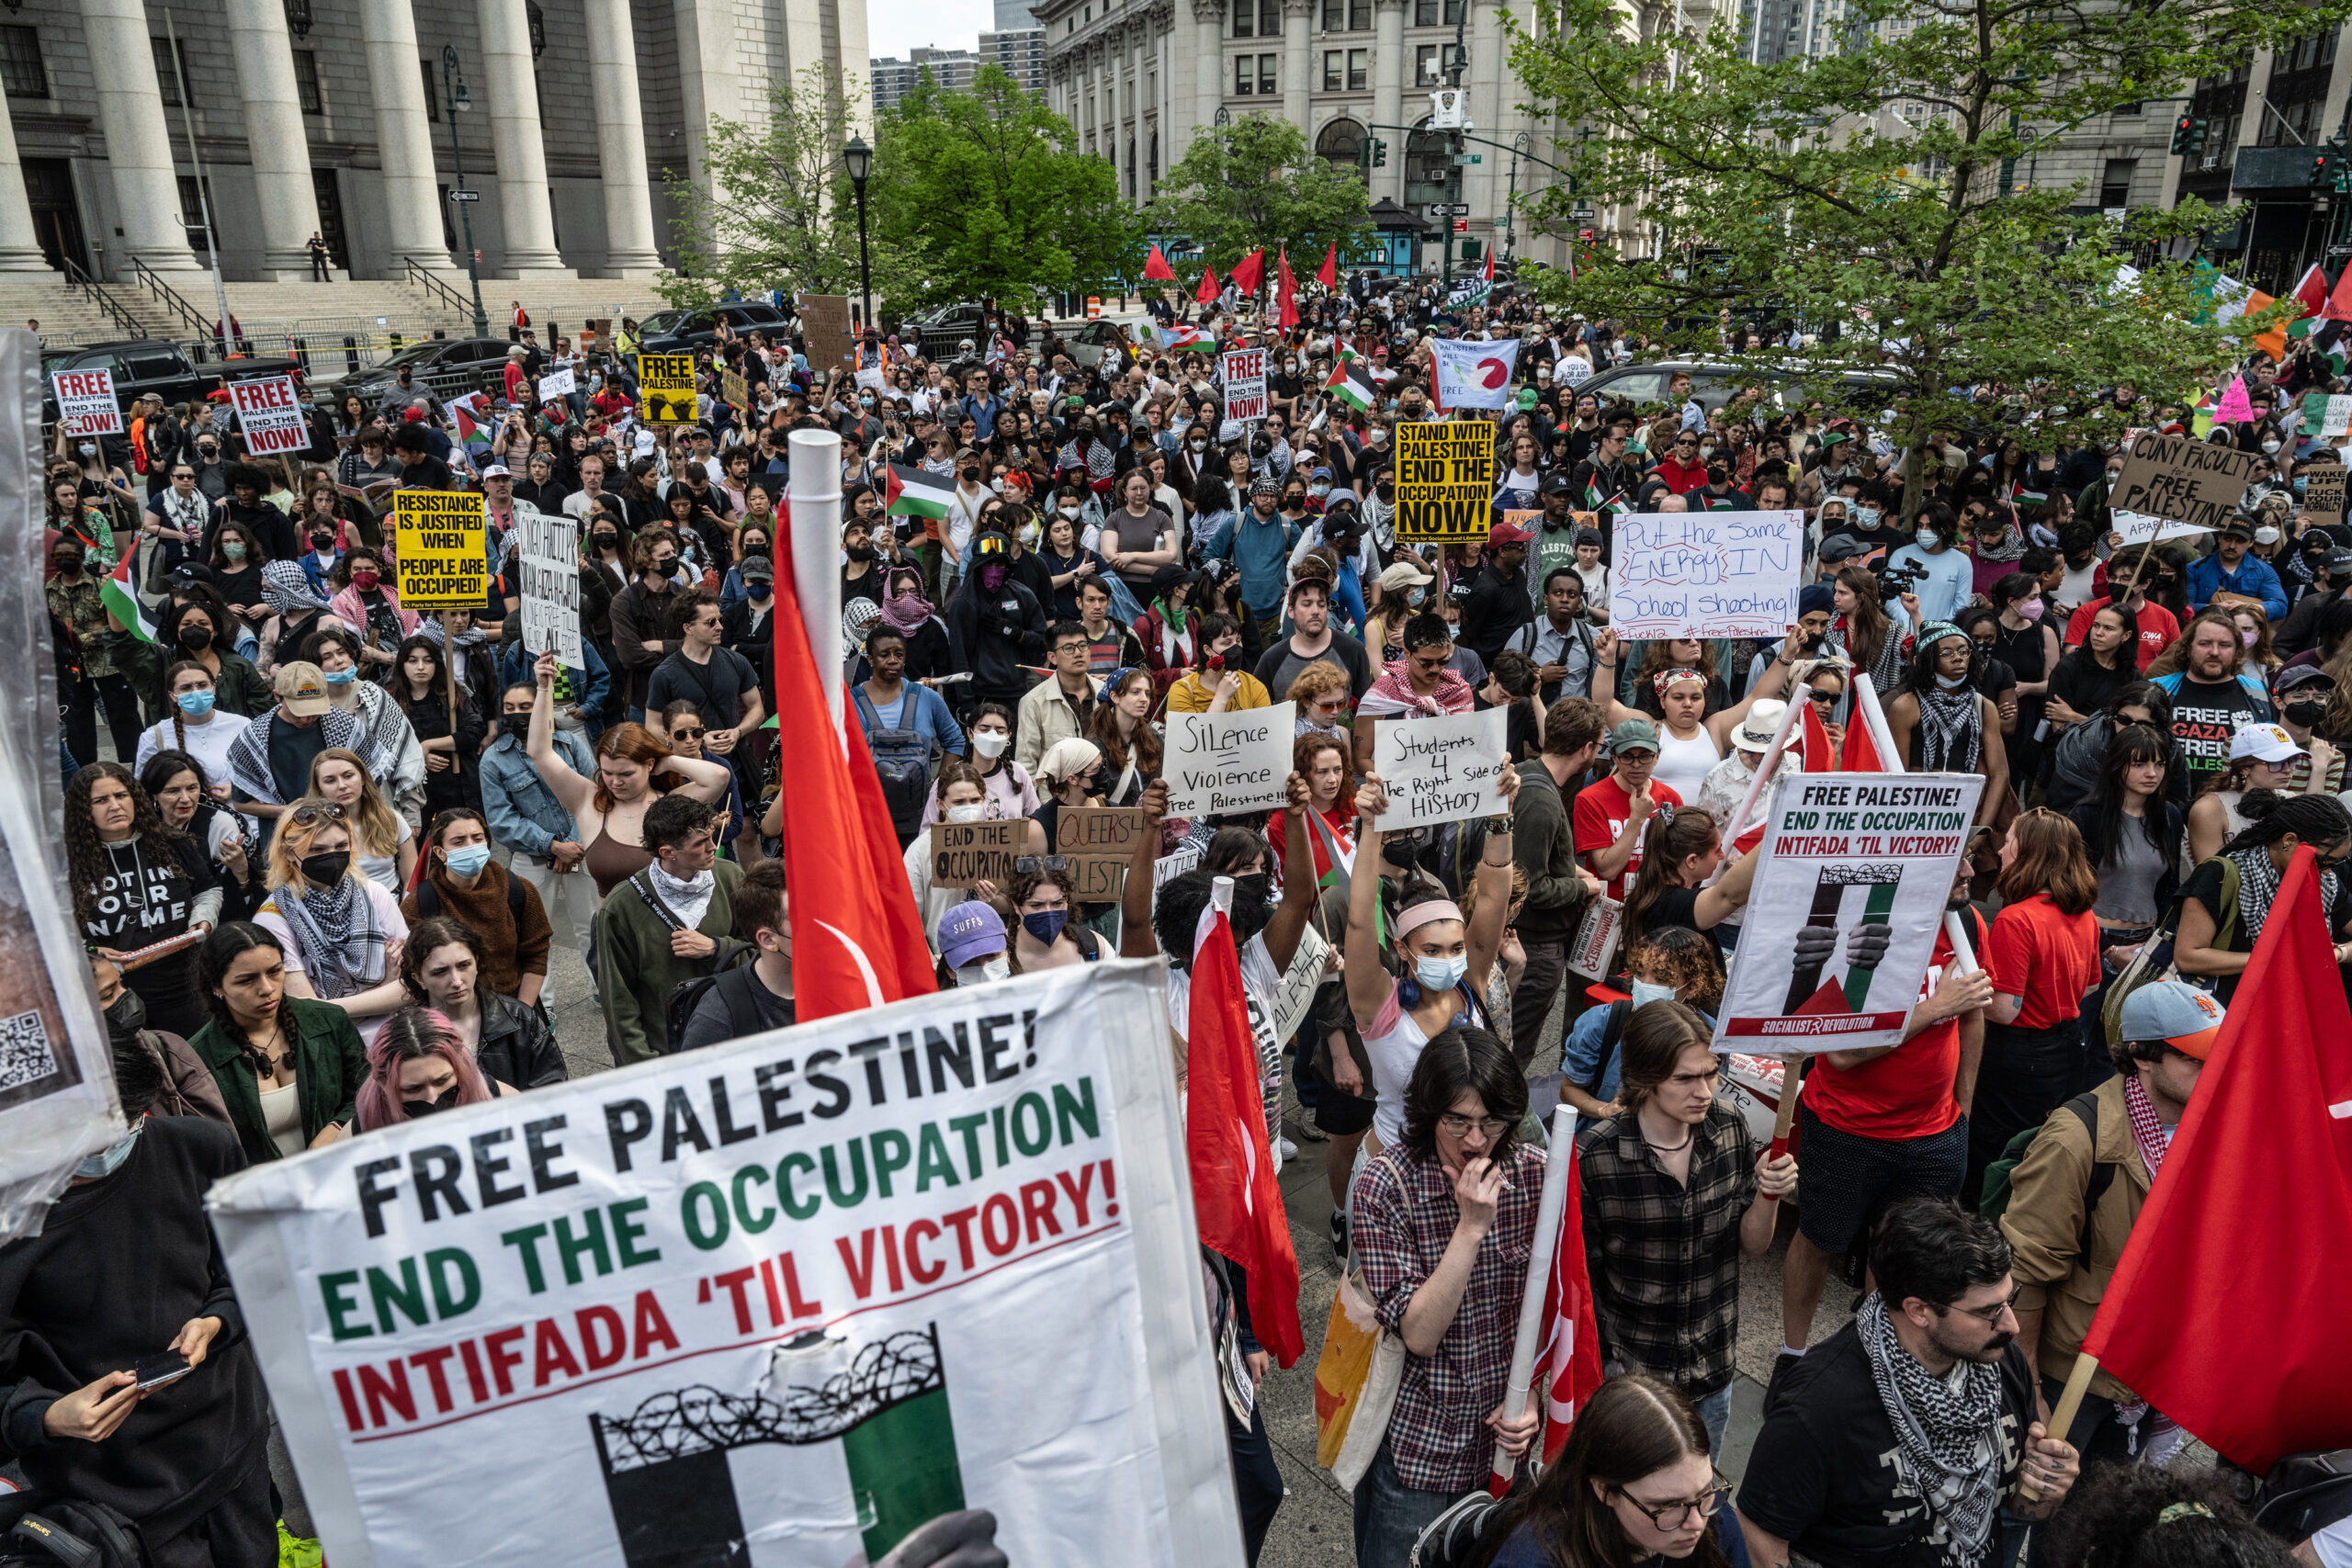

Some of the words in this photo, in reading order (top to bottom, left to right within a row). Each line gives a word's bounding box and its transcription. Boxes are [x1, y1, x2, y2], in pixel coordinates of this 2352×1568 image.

[1456, 155, 1473, 164] DUANE
[642, 357, 691, 378] FREE
[1227, 354, 1262, 380] FREE
[57, 373, 110, 397] FREE
[641, 378, 695, 389] PALESTINE
[726, 373, 743, 392] FREE
[1228, 377, 1262, 386] PALESTINE
[1442, 386, 1464, 395] FREE
[234, 382, 293, 411] FREE
[1228, 392, 1262, 400] OCCUPATION
[242, 406, 295, 416] PALESTINE
[1228, 397, 1263, 420] NOW!
[245, 419, 271, 427] END
[274, 415, 299, 423] THE
[247, 423, 300, 432] OCCUPATION
[249, 427, 305, 451] NOW!
[1399, 424, 1449, 441] STAND
[1453, 423, 1491, 440] WITH
[1399, 441, 1490, 458] PALESTINE!
[2134, 434, 2184, 465] CUNY
[2182, 446, 2259, 480] FACULTY
[1400, 460, 1444, 483] END
[1451, 459, 1491, 482] THE
[2171, 467, 2184, 476] for
[2309, 470, 2346, 479] WAKE
[1397, 485, 1488, 501] OCCUPATION
[2149, 474, 2202, 500] FREE
[397, 494, 481, 512] RESISTANCE
[2123, 485, 2237, 529] PALESTINE
[2304, 502, 2342, 513] NORMALCY
[399, 513, 413, 530] IS
[416, 513, 482, 530] JUSTIFIED
[1398, 501, 1486, 533] NOW!
[421, 533, 465, 548] WHEN
[1680, 522, 1721, 545] the
[400, 558, 456, 575] PEOPLE
[458, 558, 484, 575] ARE
[1729, 543, 1789, 575] IN
[405, 578, 481, 595] OCCUPIED!
[546, 627, 561, 657] ALL
[561, 634, 577, 660] FREE
[2142, 630, 2162, 640] CWA
[2173, 706, 2230, 725] FREE
[2171, 723, 2229, 740] GAZA
[1394, 728, 1475, 761] Students
[1431, 755, 1447, 773] 4
[1182, 768, 1271, 792] Violence
[1383, 780, 1404, 796] The
[1413, 773, 1452, 795] Right
[1802, 786, 1851, 807] FREE
[1855, 787, 1962, 807] PALESTINE!
[1058, 813, 1129, 848] QUEERS
[1130, 815, 1146, 833] 4
[1782, 811, 1820, 831] END
[1825, 811, 1860, 831] THE
[1860, 811, 1966, 831] OCCUPATION
[944, 827, 974, 847] END
[977, 826, 1011, 845] THE
[1774, 836, 1849, 855] INTIFADA
[1888, 835, 1961, 855] VICTORY!
[147, 866, 175, 882] IN
[953, 917, 983, 934] SUFFS
[1587, 921, 1596, 933] NEW
[1589, 911, 1615, 962] COMMUNIST
[1761, 1020, 1811, 1033] SOCIALIST
[1822, 1017, 1876, 1032] REVOLUTION
[1720, 1080, 1750, 1110] The
[355, 1113, 580, 1238] FREE
[604, 1010, 1038, 1173] PALESTINE!
[319, 1247, 481, 1341] END
[501, 1196, 662, 1294] THE
[681, 1077, 1101, 1251] OCCUPATION
[333, 1291, 681, 1431] INTIFADA
[834, 1158, 1120, 1300] VICTORY!
